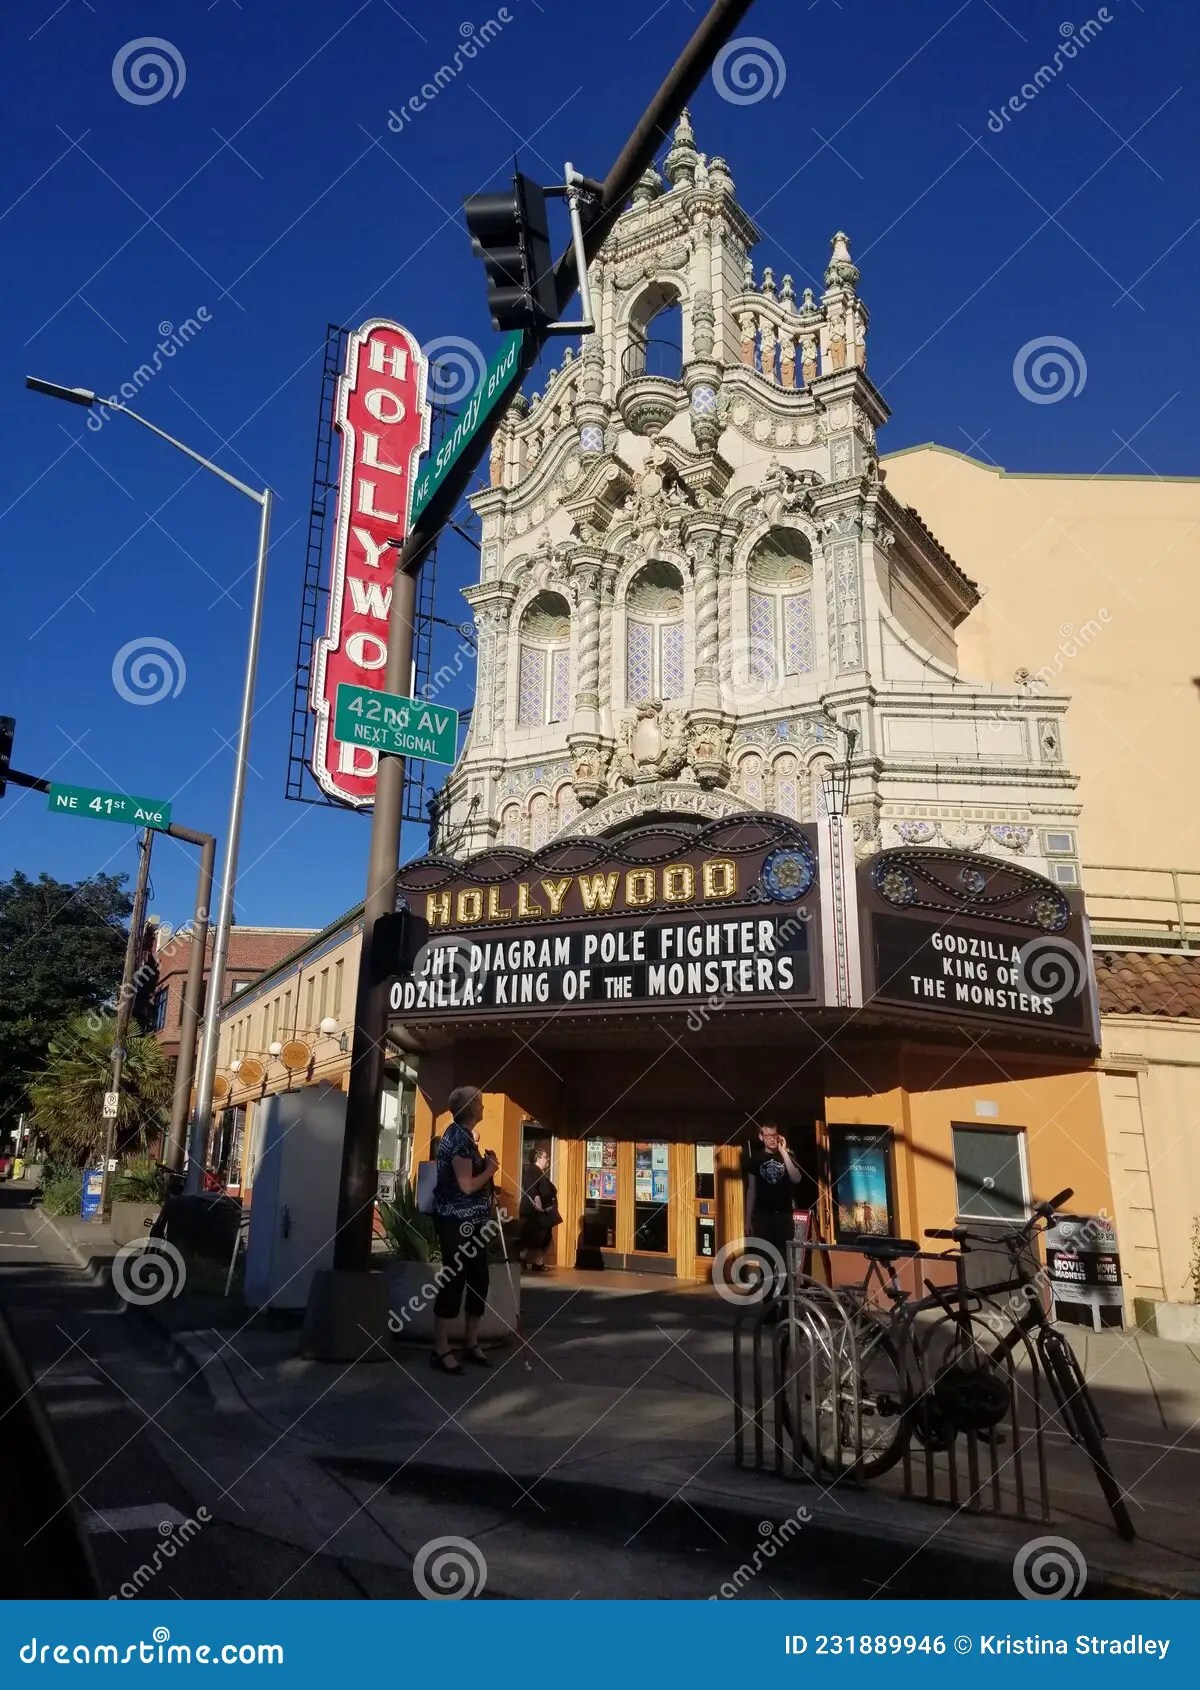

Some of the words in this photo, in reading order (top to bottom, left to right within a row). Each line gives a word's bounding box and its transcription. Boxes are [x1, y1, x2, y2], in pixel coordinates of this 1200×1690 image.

[416, 475, 431, 506] NE
[434, 393, 481, 478] Sandy
[487, 342, 515, 399] Blvd
[336, 338, 408, 777] HOLLYWOD
[348, 696, 410, 728] 42nd
[417, 711, 449, 736] AV
[354, 723, 389, 744] NEXT
[394, 733, 439, 755] SIGNAL
[57, 795, 78, 809] NE
[88, 796, 126, 814] 41st
[134, 808, 162, 823] Ave
[426, 858, 736, 927] HOLLYWOOD
[470, 936, 571, 973] DIAGRAM
[584, 931, 645, 964] POLE
[661, 920, 775, 959] FIGHTER
[931, 932, 1022, 964] GODZILLA
[390, 978, 483, 1010] ODZILLA:
[496, 972, 549, 1004] KING
[562, 970, 591, 1000] OF
[604, 976, 632, 999] THE
[648, 957, 794, 996] MONSTERS
[942, 957, 988, 981] KING
[997, 966, 1019, 987] OF
[911, 975, 946, 999] THE
[956, 982, 1054, 1016] MONSTERS
[1054, 1260, 1085, 1273] MOVIE
[1055, 1270, 1087, 1281] MADNESS
[1096, 1263, 1117, 1275] MOVIE
